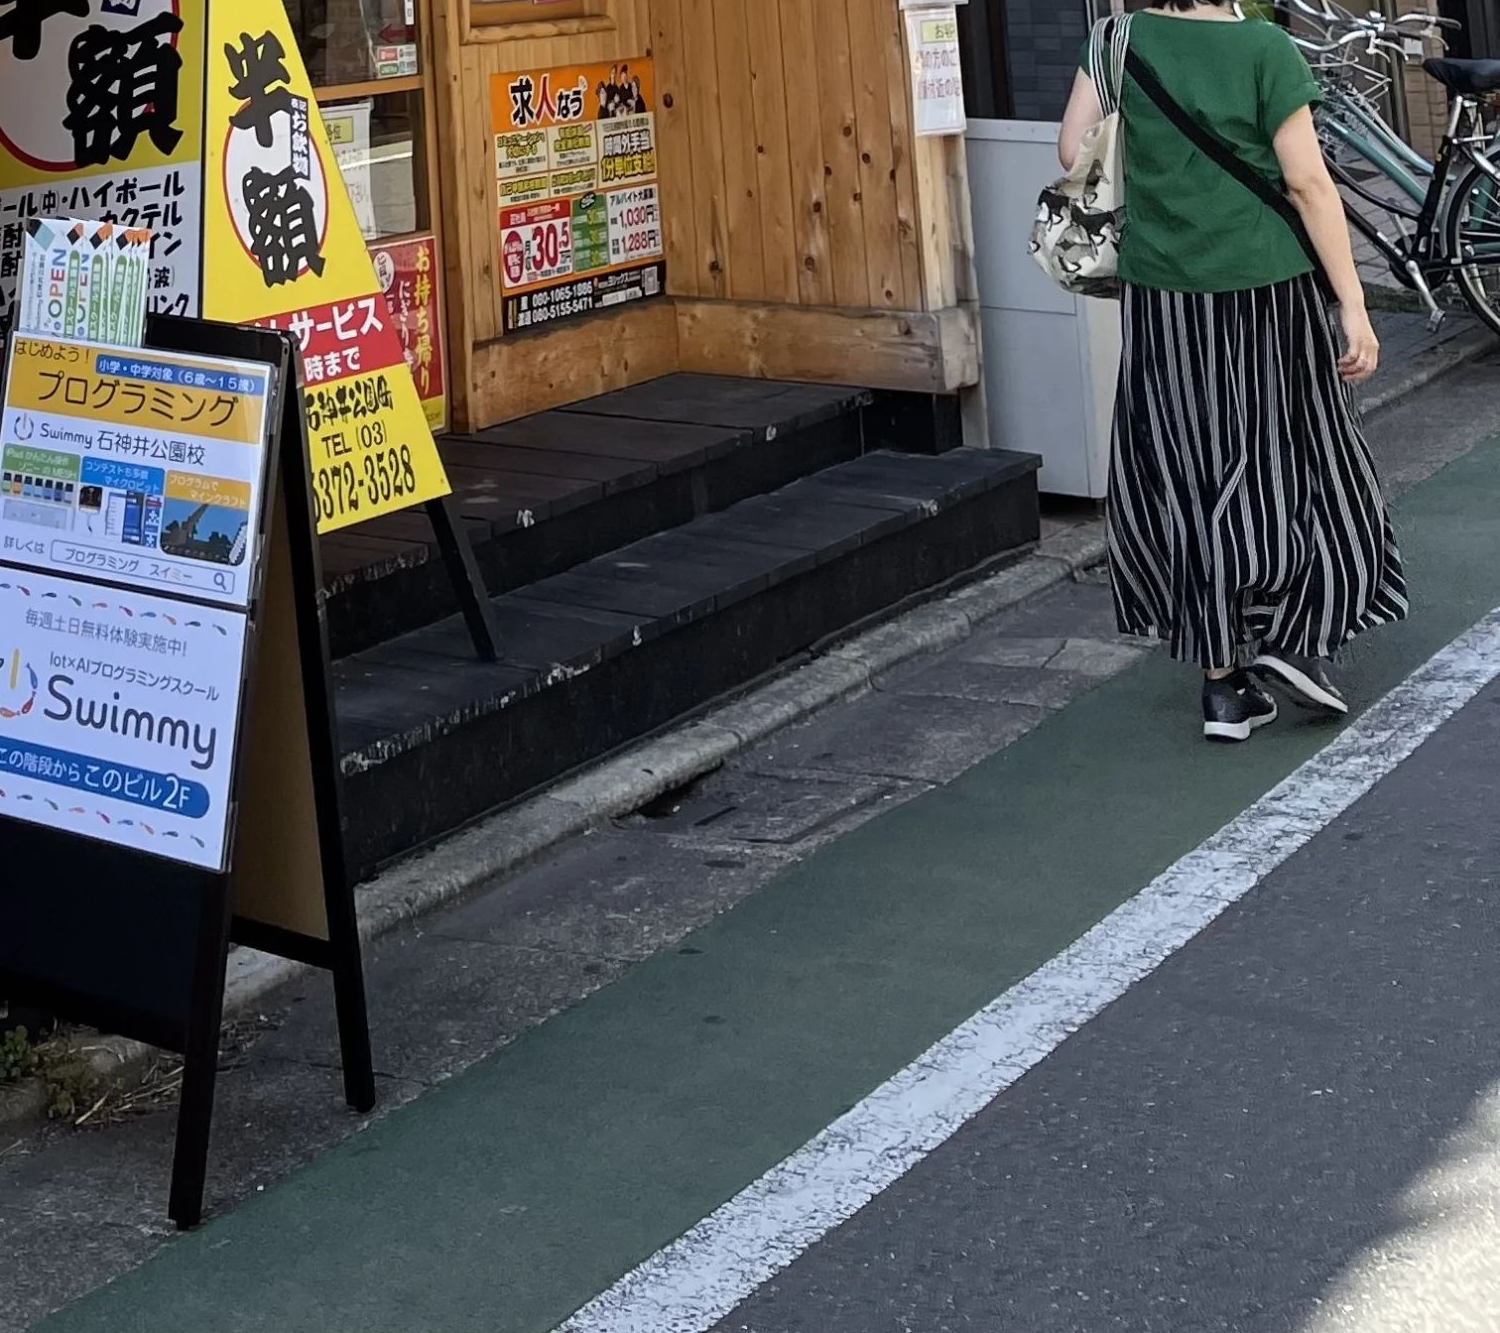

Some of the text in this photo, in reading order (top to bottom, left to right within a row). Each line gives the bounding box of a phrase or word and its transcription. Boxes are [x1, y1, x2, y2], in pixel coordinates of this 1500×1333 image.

[223, 30, 326, 289] 半額
[38, 369, 239, 428] プログラミング
[39, 421, 206, 467] Swimmy 石神井公園校
[321, 432, 352, 460] TEL
[3, 534, 194, 582] 詳しくは プログラミング スイミー
[43, 673, 218, 771] Swimmy
